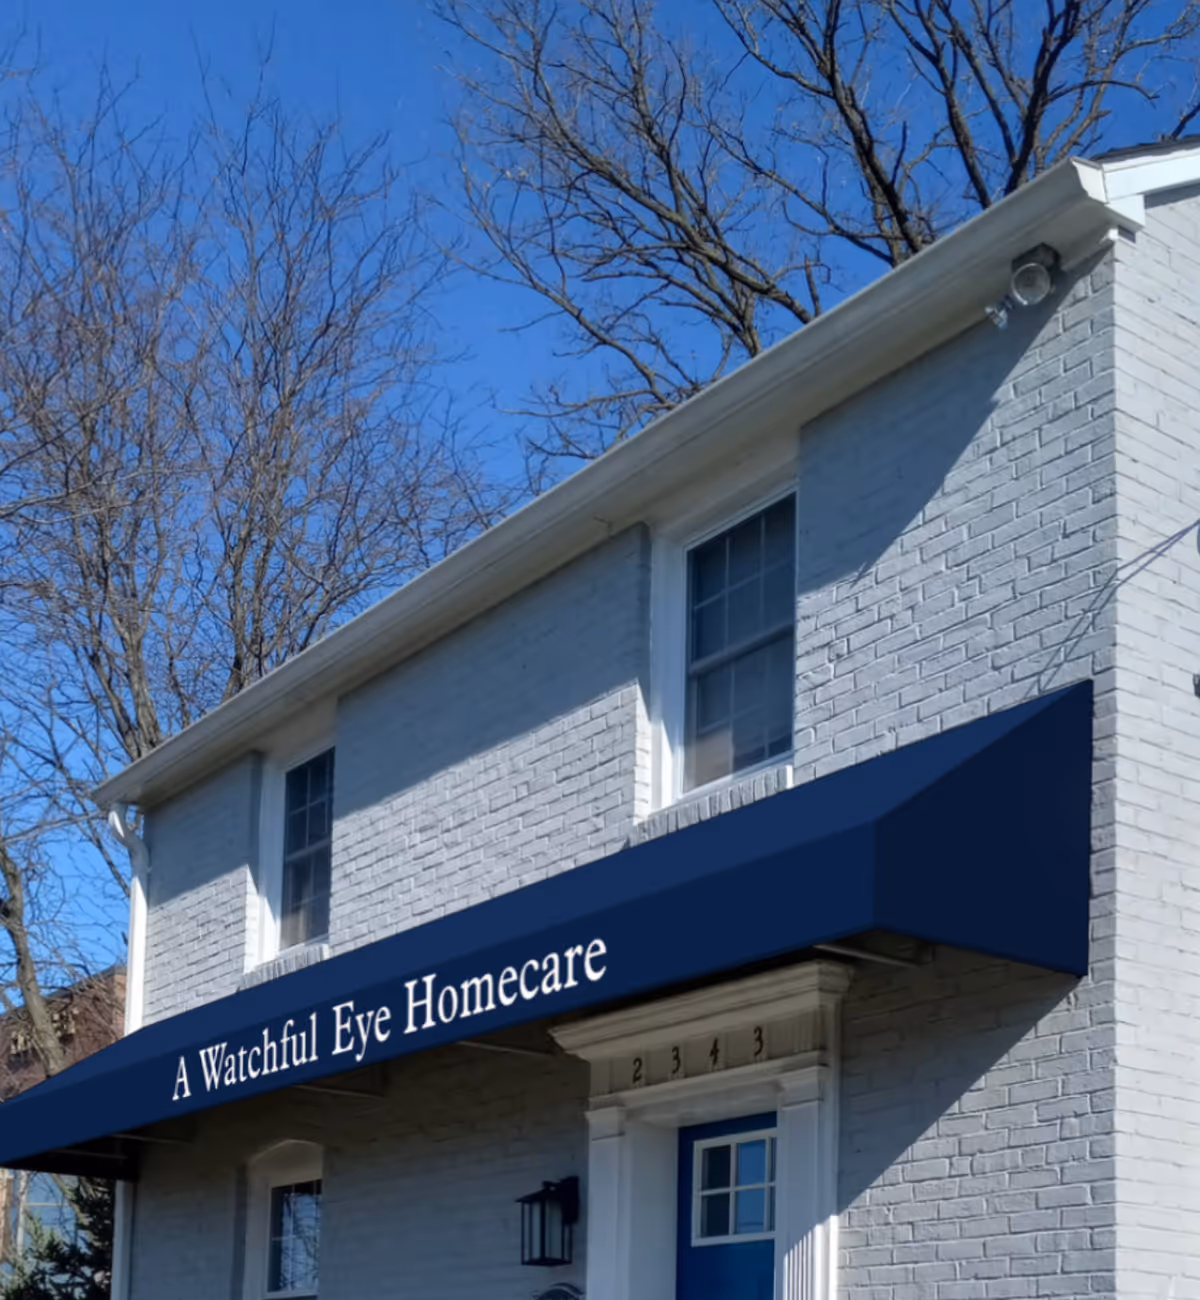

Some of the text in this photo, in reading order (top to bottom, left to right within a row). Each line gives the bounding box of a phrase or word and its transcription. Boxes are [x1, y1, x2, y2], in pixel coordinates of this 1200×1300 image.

[172, 937, 608, 1101] A Watchful Eye Homecare
